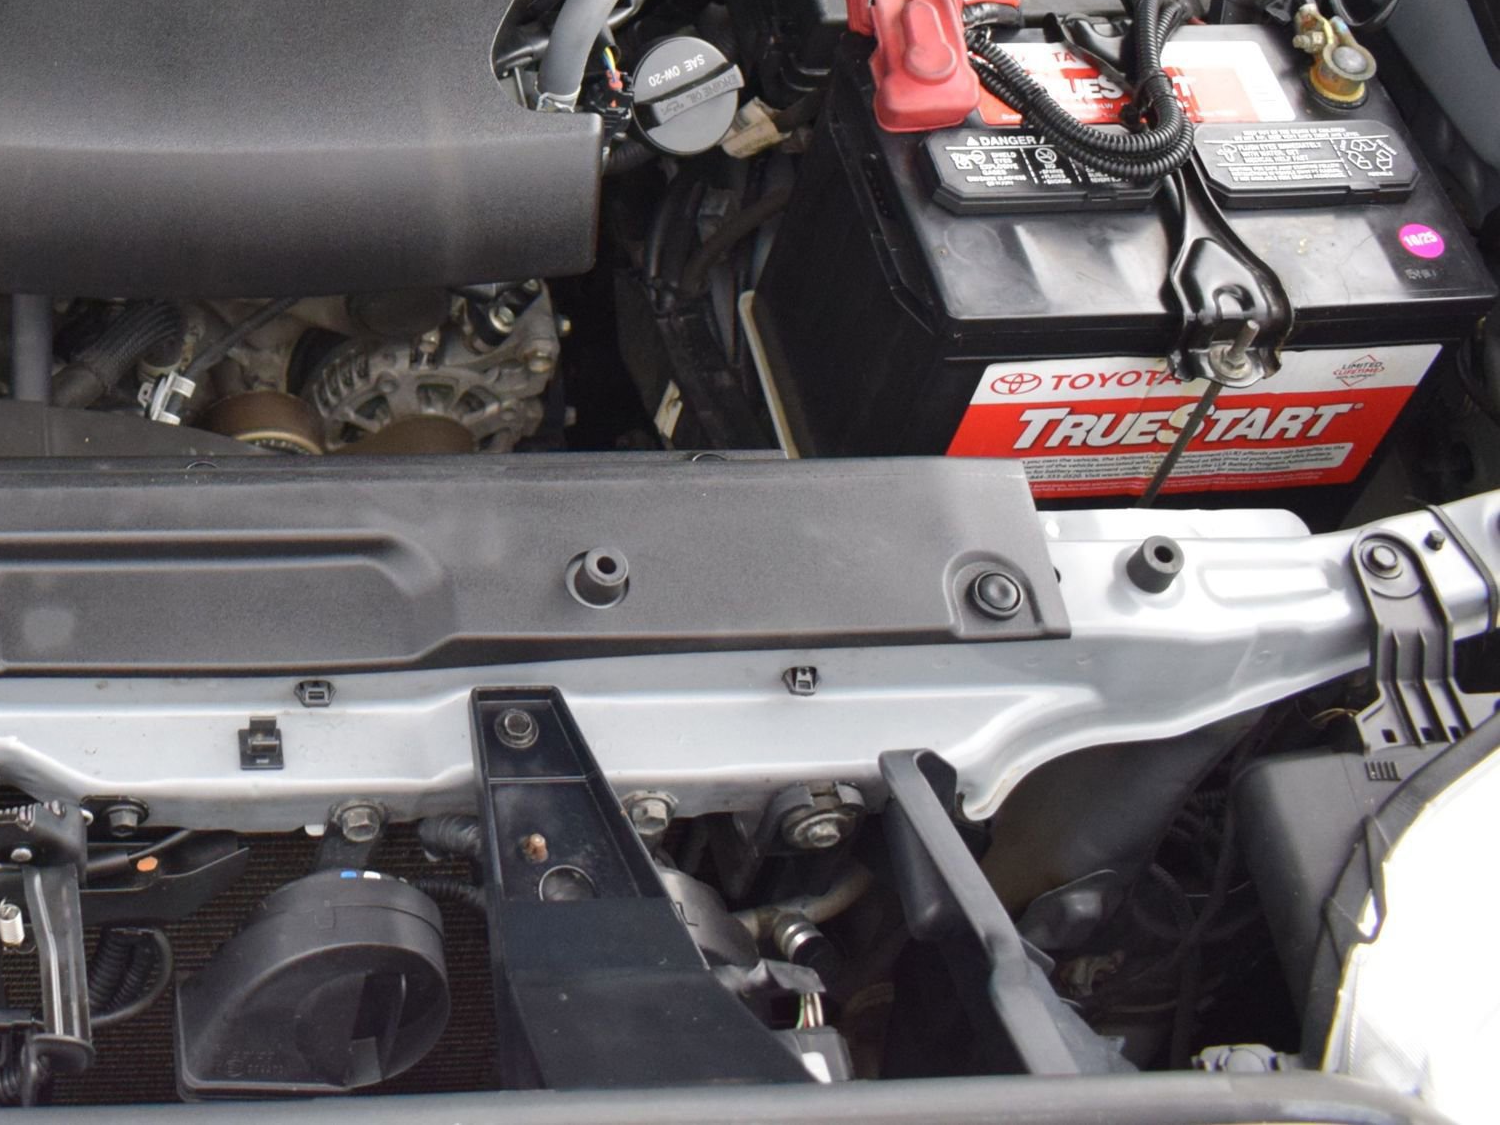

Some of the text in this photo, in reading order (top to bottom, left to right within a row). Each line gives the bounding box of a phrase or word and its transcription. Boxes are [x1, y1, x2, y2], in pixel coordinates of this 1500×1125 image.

[648, 54, 705, 87] SAE 0W-20
[979, 135, 1037, 146] DANGER
[1403, 231, 1438, 247] 10/25
[1341, 361, 1383, 370] LIMITED
[1051, 369, 1182, 391] TOYOTA
